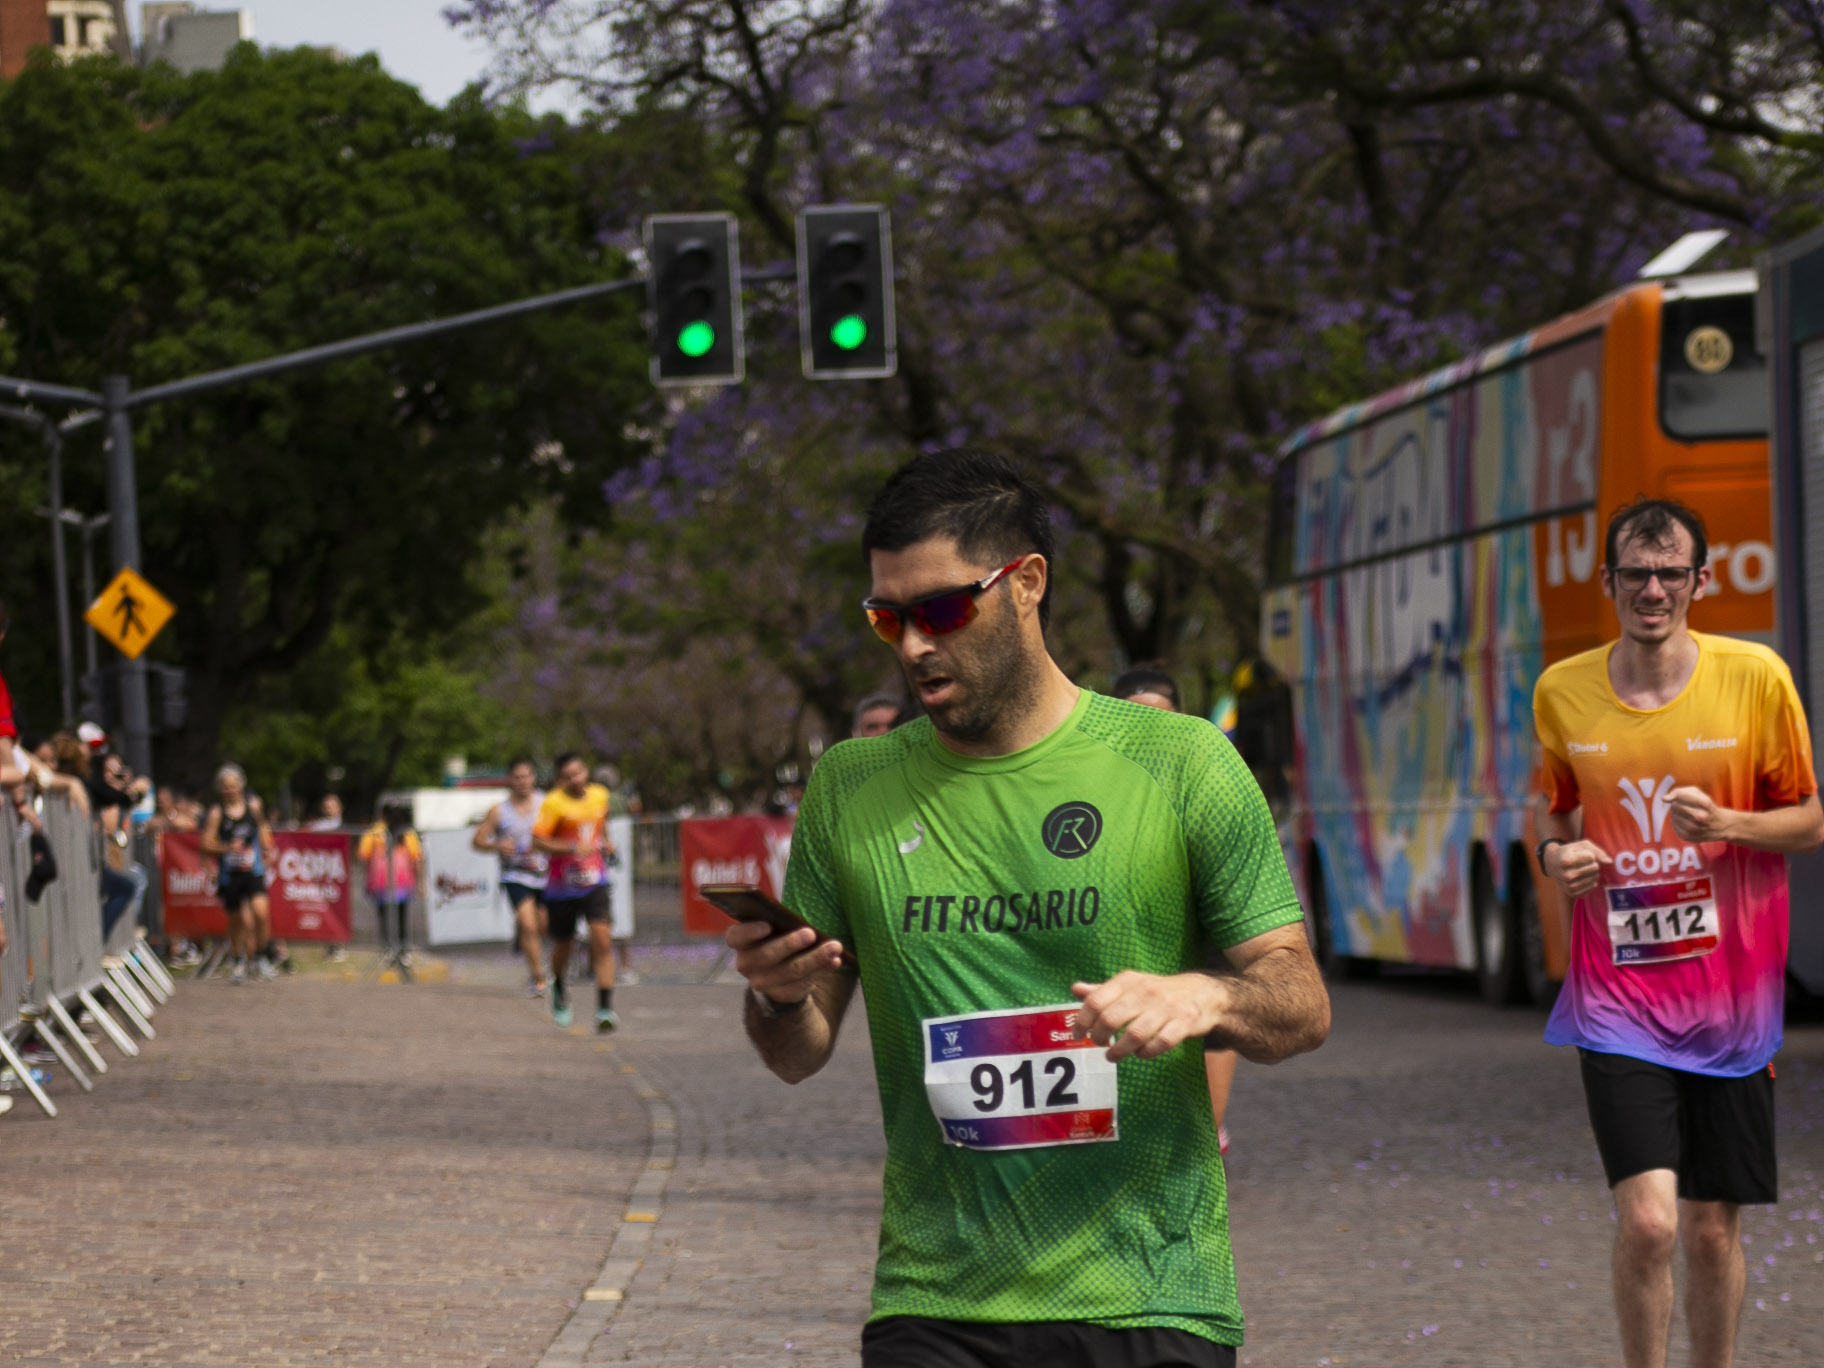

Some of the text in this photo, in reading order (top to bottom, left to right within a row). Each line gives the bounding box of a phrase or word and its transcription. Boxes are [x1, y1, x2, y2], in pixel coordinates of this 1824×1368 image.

[1615, 845, 1702, 876] COPA
[1624, 905, 1706, 941] 1112
[970, 1056, 1079, 1113] 912
[951, 1126, 979, 1141] 10k
